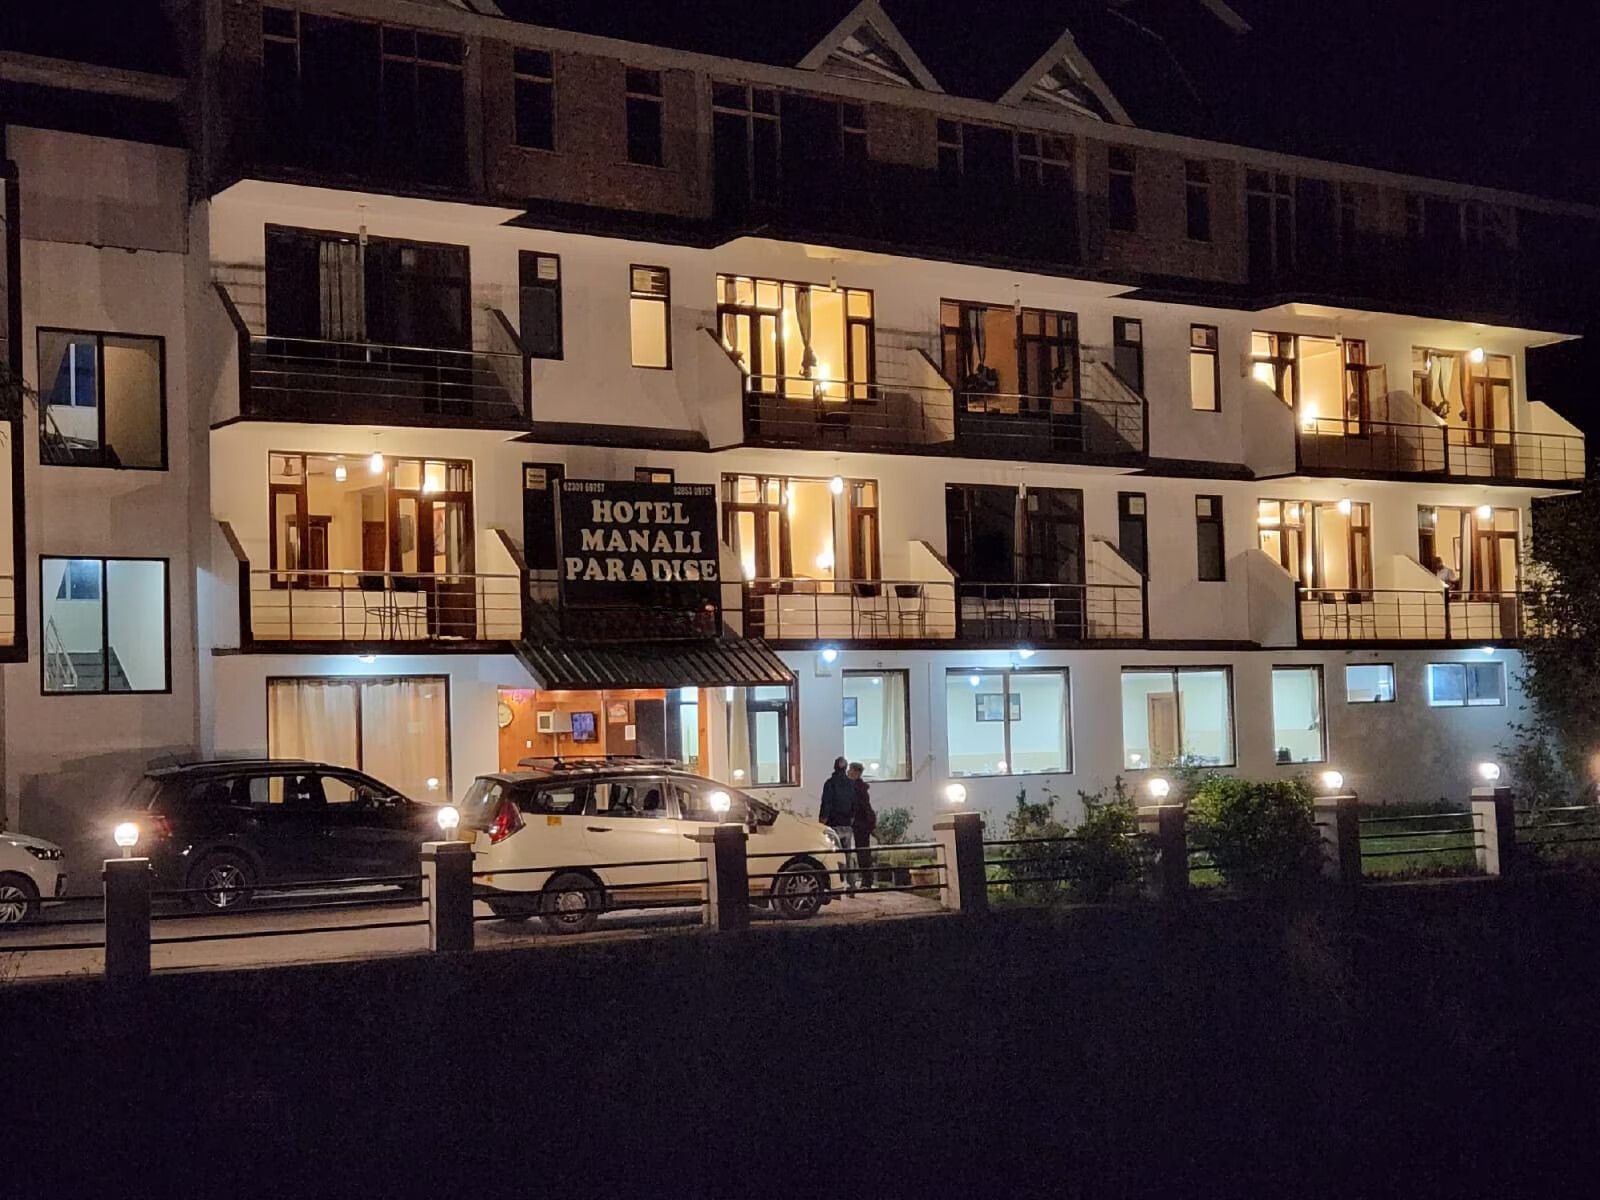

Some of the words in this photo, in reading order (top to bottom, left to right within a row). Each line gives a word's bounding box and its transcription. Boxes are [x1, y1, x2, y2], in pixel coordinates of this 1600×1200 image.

[591, 499, 690, 525] HOTEL
[581, 528, 703, 553] MANALI
[565, 557, 718, 582] PARADISE
